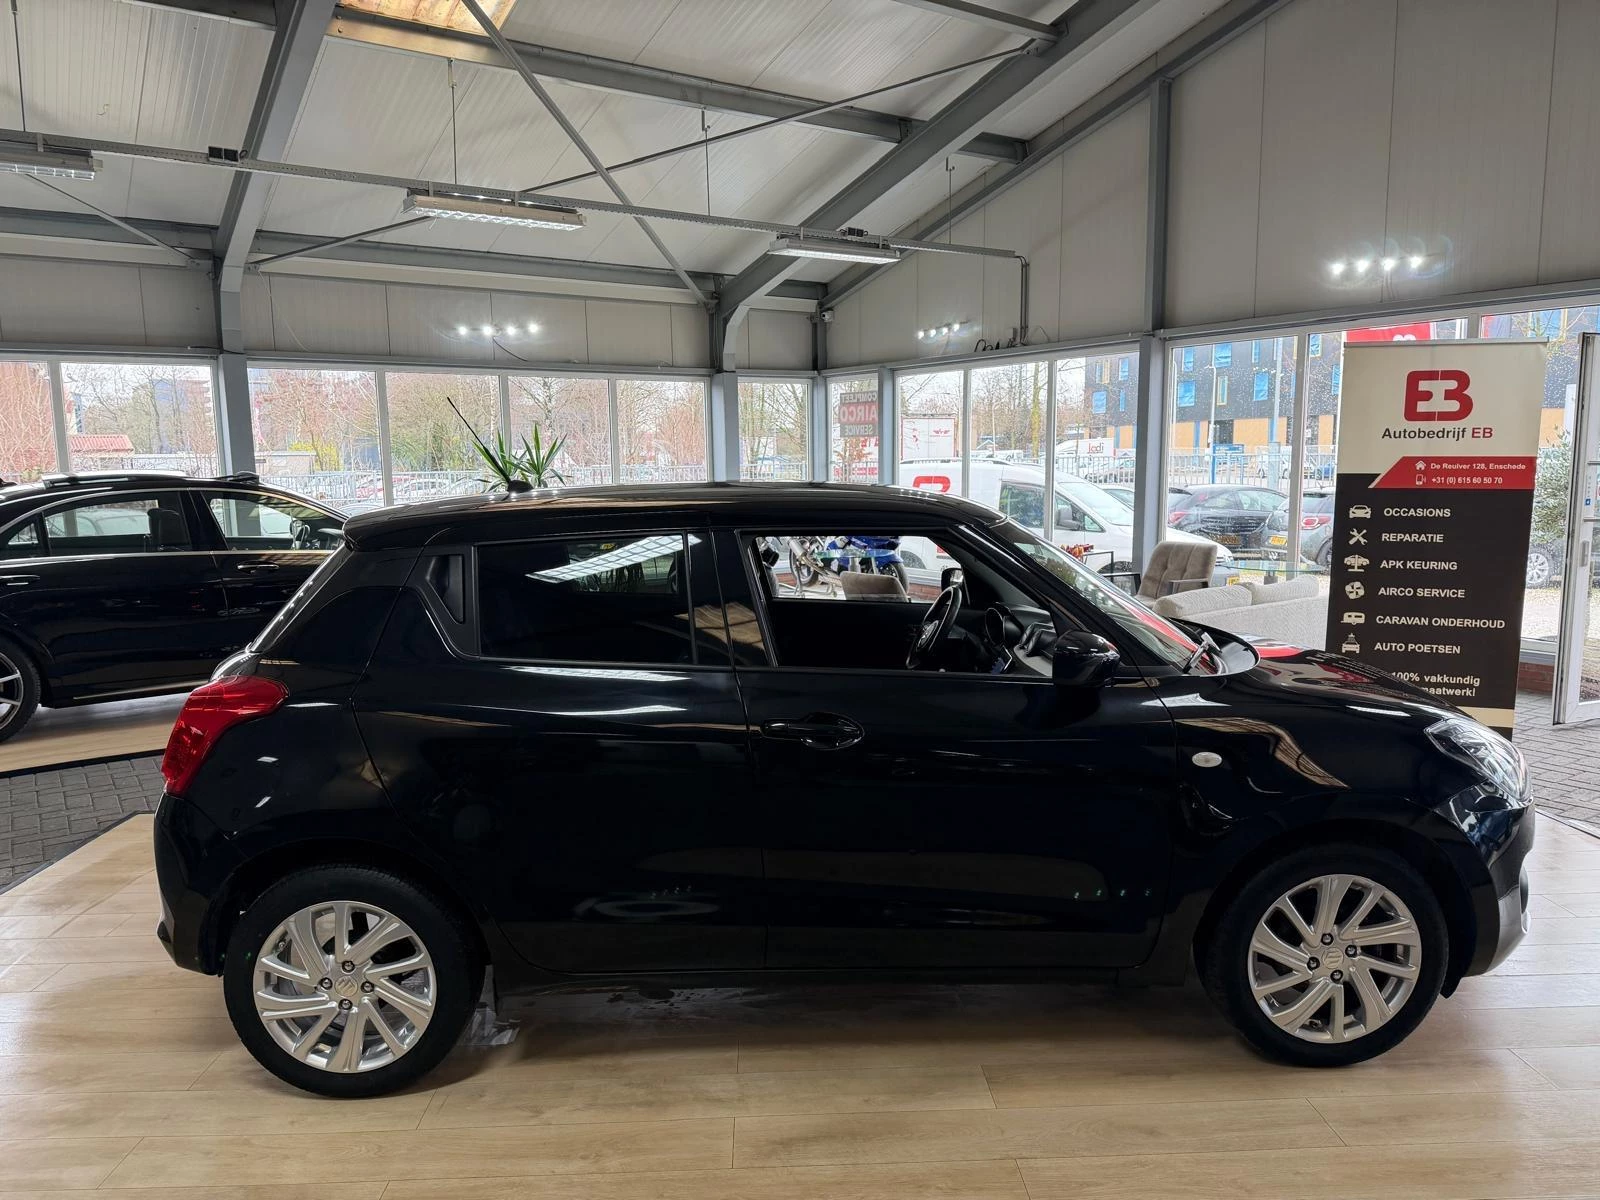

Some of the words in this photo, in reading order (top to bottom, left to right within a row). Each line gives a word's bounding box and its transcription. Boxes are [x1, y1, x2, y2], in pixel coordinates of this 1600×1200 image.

[1381, 427, 1466, 441] Autobedrijf
[1471, 427, 1493, 439] EB
[1446, 476, 1456, 485] (0)
[1383, 507, 1451, 518] OCCASIONS
[1381, 533, 1444, 543] REPARATIE
[1380, 560, 1404, 569] APK
[1406, 561, 1458, 571] KEURING
[1378, 587, 1414, 597] AIRCO
[1416, 588, 1465, 598] SERVICE
[1376, 615, 1429, 626] CARAVAN
[1431, 617, 1505, 629] ONDERHOUD
[1374, 642, 1405, 652] AUTO
[1408, 643, 1461, 654] POETSEN
[1423, 674, 1481, 687] vakkundig
